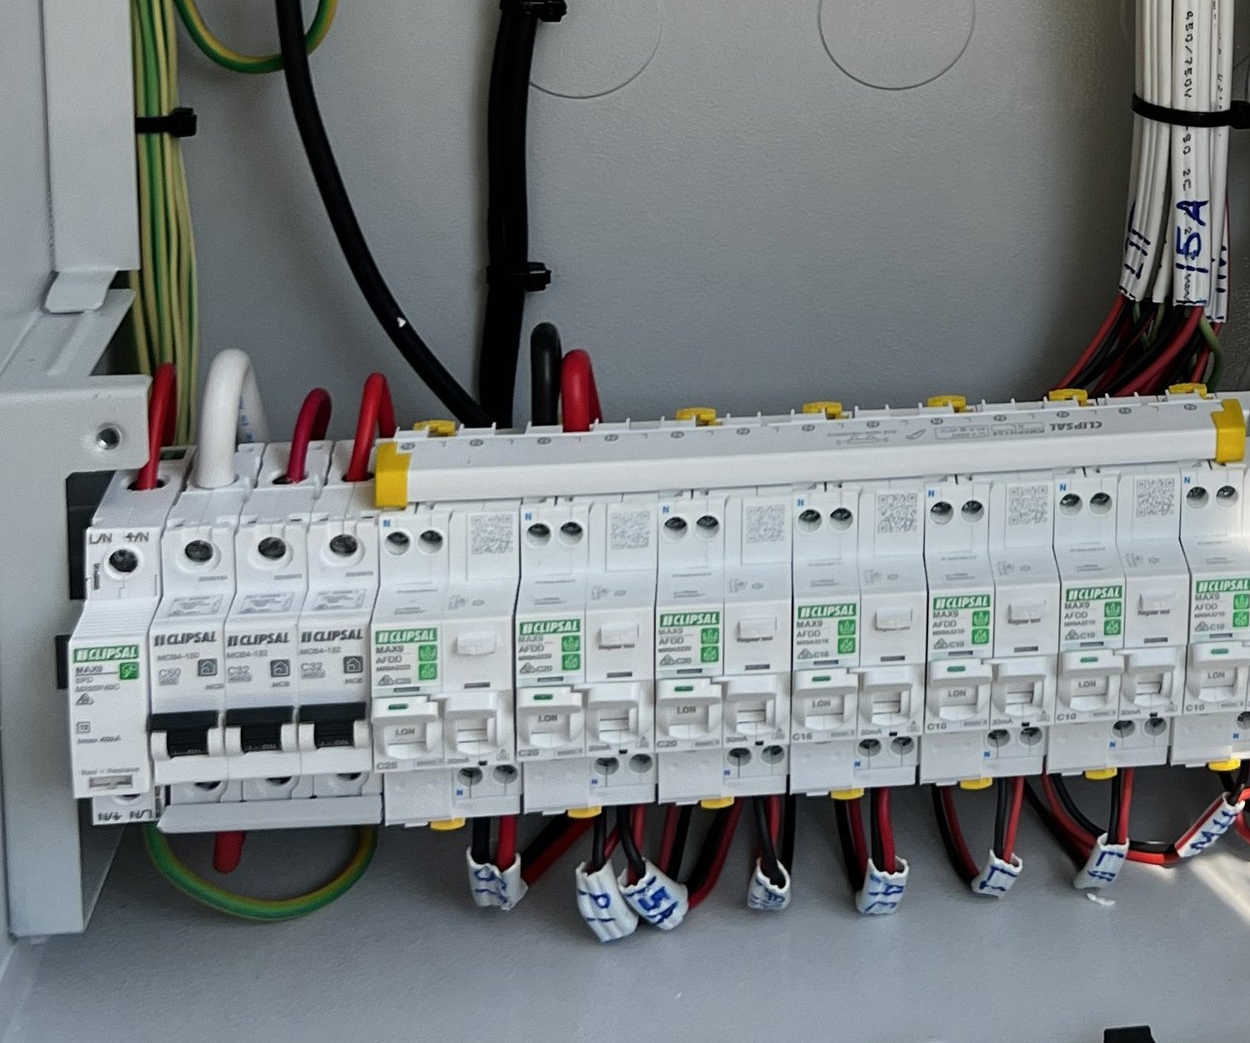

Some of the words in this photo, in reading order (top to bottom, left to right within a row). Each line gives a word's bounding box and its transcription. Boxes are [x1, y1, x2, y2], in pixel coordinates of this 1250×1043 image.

[1050, 421, 1103, 433] CLIPSAL
[1208, 579, 1249, 592] CLIPSAL
[1078, 586, 1120, 599] CLIPSAL
[946, 596, 989, 609] CLIPSAL
[811, 604, 855, 617] CLIPSAL
[673, 613, 718, 626] CLIPSAL
[534, 620, 579, 633] CLIPSAL
[167, 631, 218, 646] CLIPSAL
[240, 632, 290, 646] CLIPSAL
[313, 628, 363, 643] CLIPSAL
[390, 630, 434, 642] CLIPSAL
[87, 646, 137, 660] CLIPSAL
